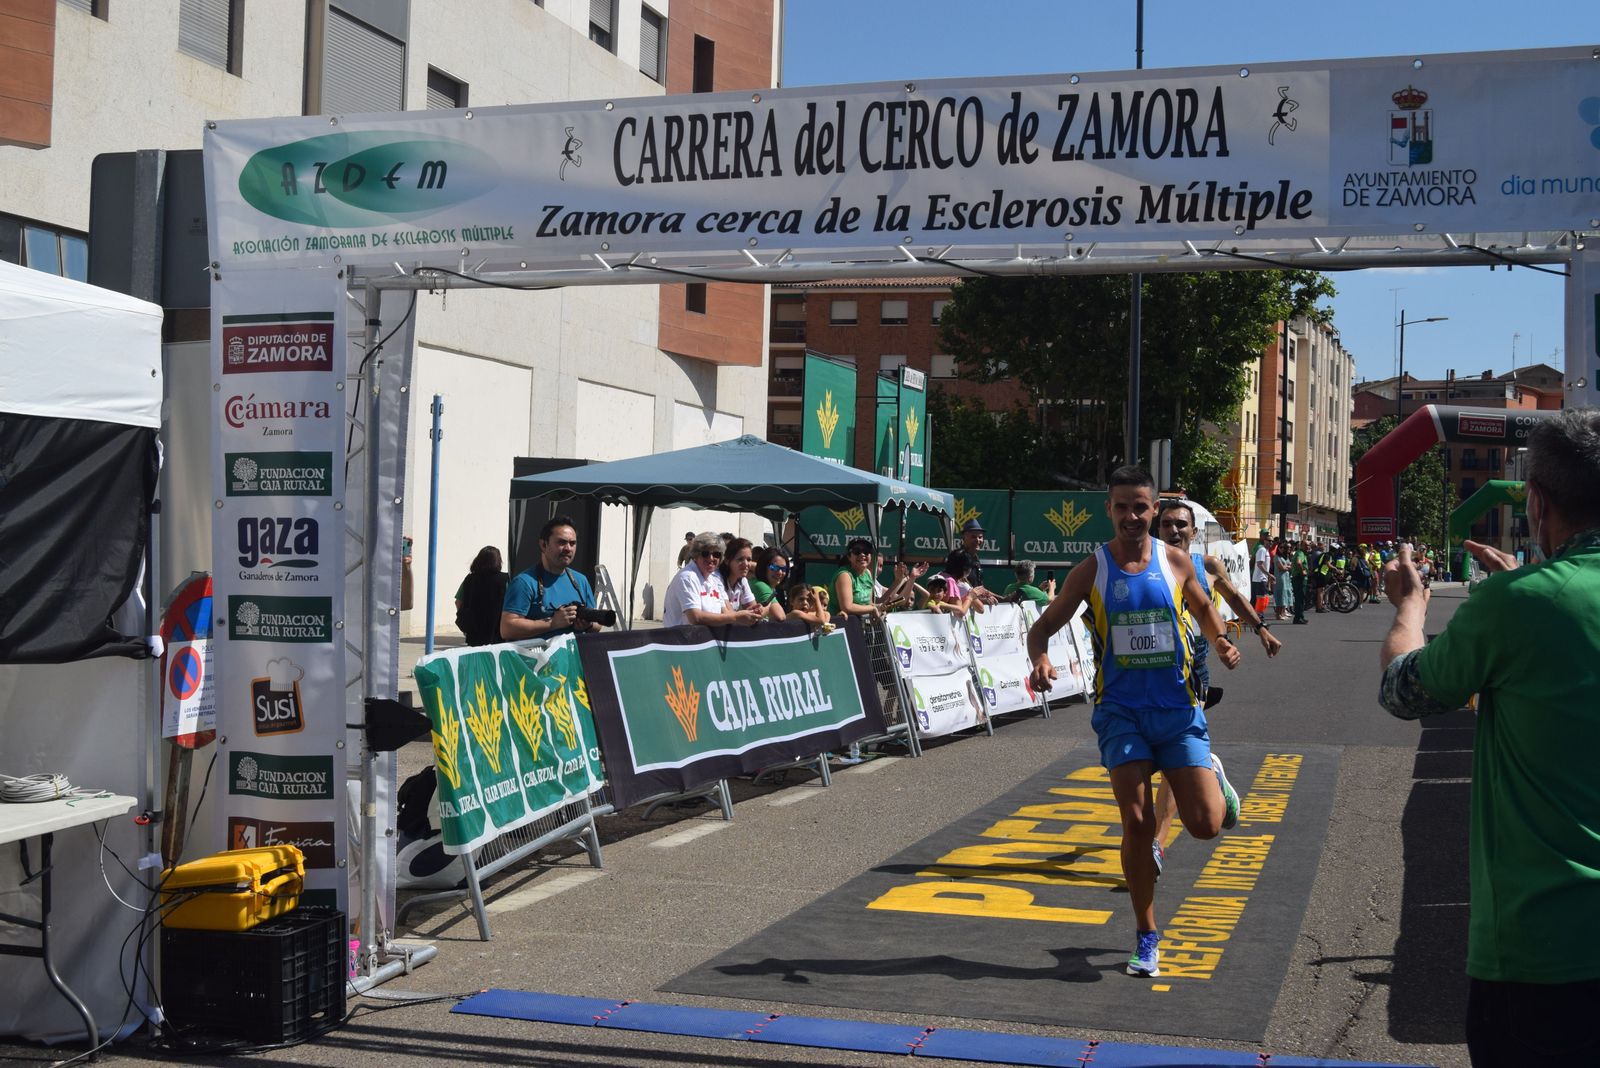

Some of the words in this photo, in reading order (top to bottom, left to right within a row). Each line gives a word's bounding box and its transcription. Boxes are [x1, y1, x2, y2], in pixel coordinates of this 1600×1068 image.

[613, 108, 782, 186] CARRERA
[794, 100, 845, 176] del
[859, 96, 984, 174] CERCO
[998, 91, 1039, 166] de
[1052, 86, 1230, 162] ZAMORA
[1343, 169, 1477, 187] AYUNTAMIENTO
[1501, 174, 1535, 195] dia
[1343, 188, 1370, 207] DE
[1376, 186, 1476, 207] ZAMORA
[535, 205, 686, 238] Zamora
[696, 207, 803, 234] cerca
[814, 197, 860, 234] de
[873, 195, 911, 232] la
[922, 186, 1123, 231] Esclerosis
[1135, 180, 1313, 230] Múltiple
[233, 235, 299, 255] ASOCIACIÓN
[305, 232, 366, 250] ZAMORANA
[372, 232, 387, 246] DE
[394, 229, 456, 247] ESCLEROSIS
[461, 224, 514, 242] MÚLTIPLE
[248, 332, 308, 346] DIPUTACIÓN
[311, 333, 327, 343] DE
[247, 345, 328, 364] ZAMORA
[1515, 416, 1541, 426] CON
[262, 426, 293, 436] Zamora
[1469, 425, 1503, 433] ZAMORA
[260, 468, 325, 479] FUNDACION
[260, 481, 281, 491] CAJA
[283, 480, 325, 491] RURAL
[237, 517, 319, 568] gaza
[809, 534, 841, 546] CAJA
[914, 536, 948, 549] CAJA
[1023, 541, 1058, 554] CAJA
[239, 571, 274, 581] Ganaderos
[274, 571, 283, 581] de
[284, 571, 319, 582] Zamora
[261, 614, 325, 626] FUNDACION
[260, 626, 280, 636] CAJA
[282, 627, 325, 637] RURAL
[1130, 635, 1157, 651] CODE
[1149, 655, 1171, 663] RURAL
[256, 693, 296, 722] Susi
[706, 679, 765, 733] CAJA
[759, 668, 833, 722] RURAL
[258, 769, 326, 784] FUNDACION
[258, 782, 279, 793] CAJA
[283, 784, 326, 794] RURAL
[265, 827, 332, 846] Fariña
[1193, 834, 1276, 890] INTEGRAL
[1154, 897, 1249, 979] REFORMA
